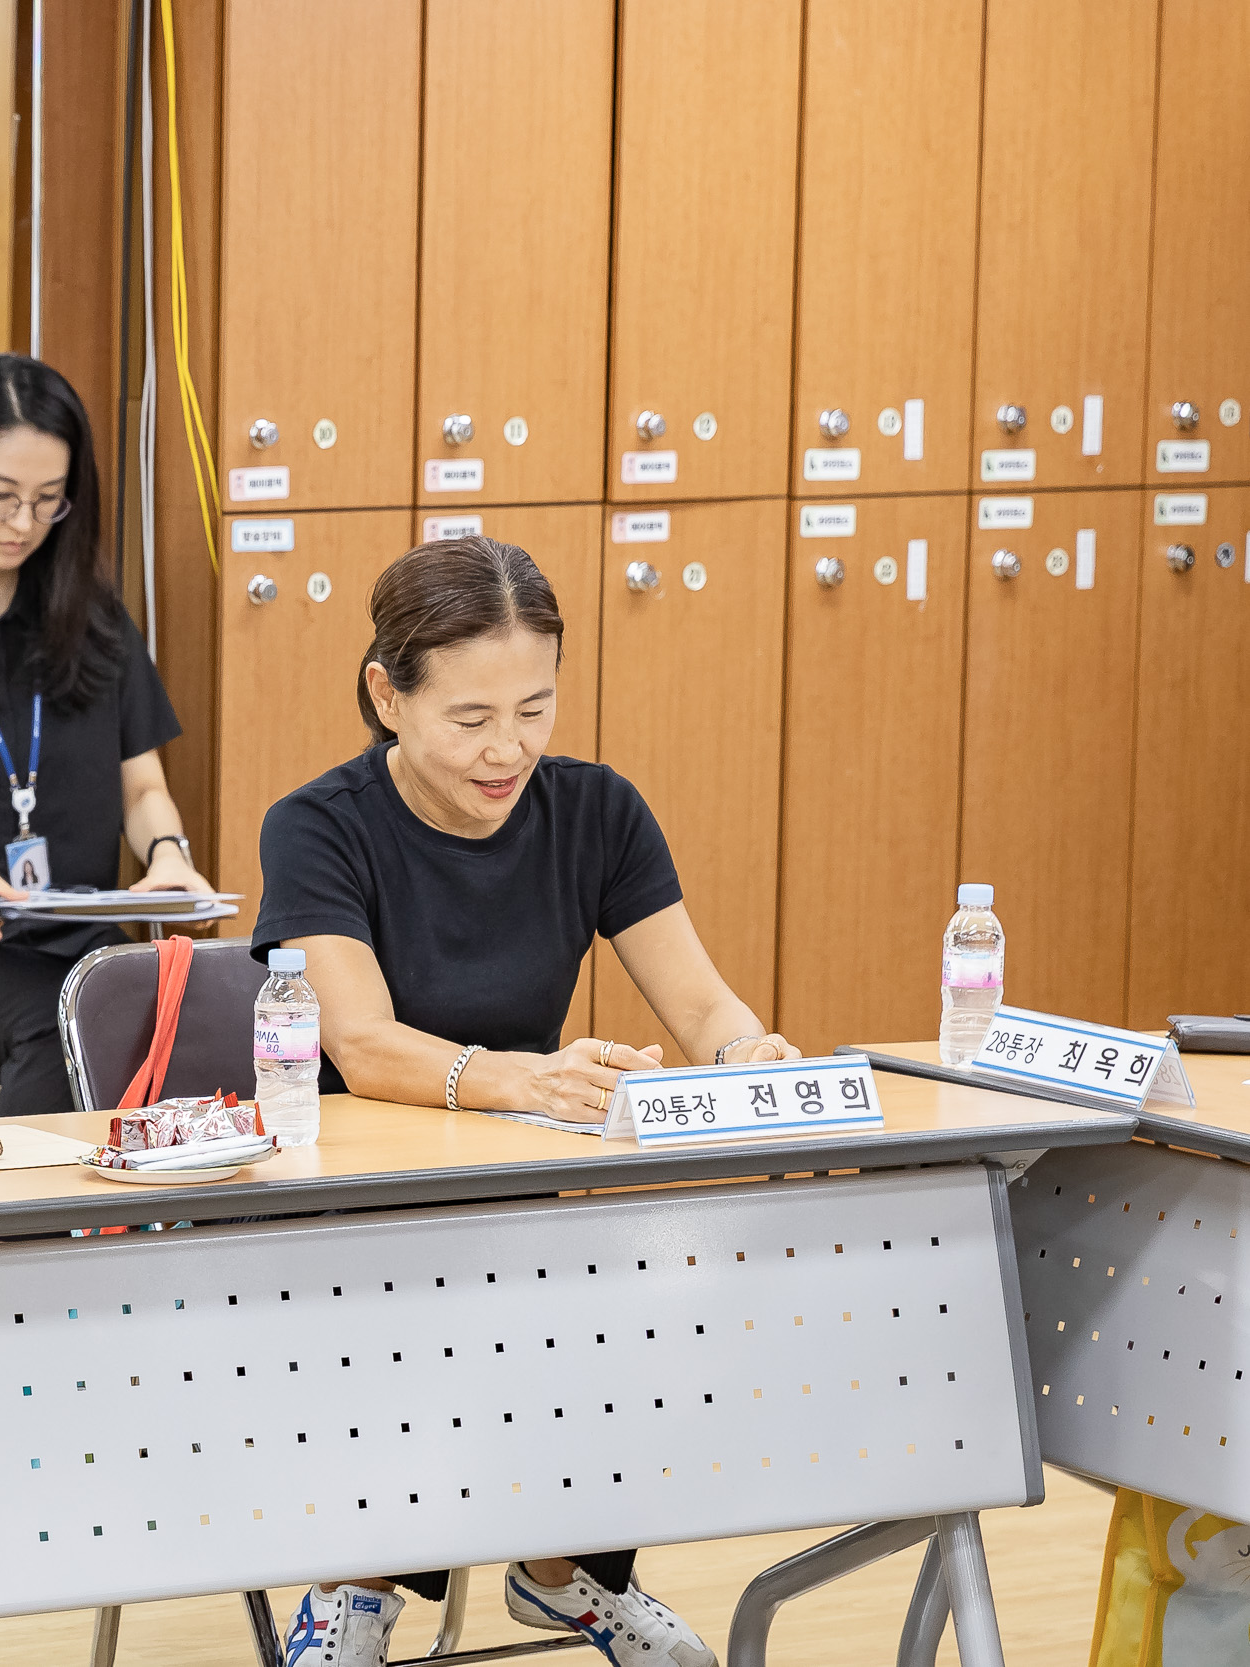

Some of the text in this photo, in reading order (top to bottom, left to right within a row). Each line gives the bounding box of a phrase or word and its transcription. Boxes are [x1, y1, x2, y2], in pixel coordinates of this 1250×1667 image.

[254, 1030, 280, 1044] 이시스
[265, 1043, 280, 1054] 8.0
[984, 1030, 1043, 1064] 28통장
[637, 1092, 717, 1126] 29통장
